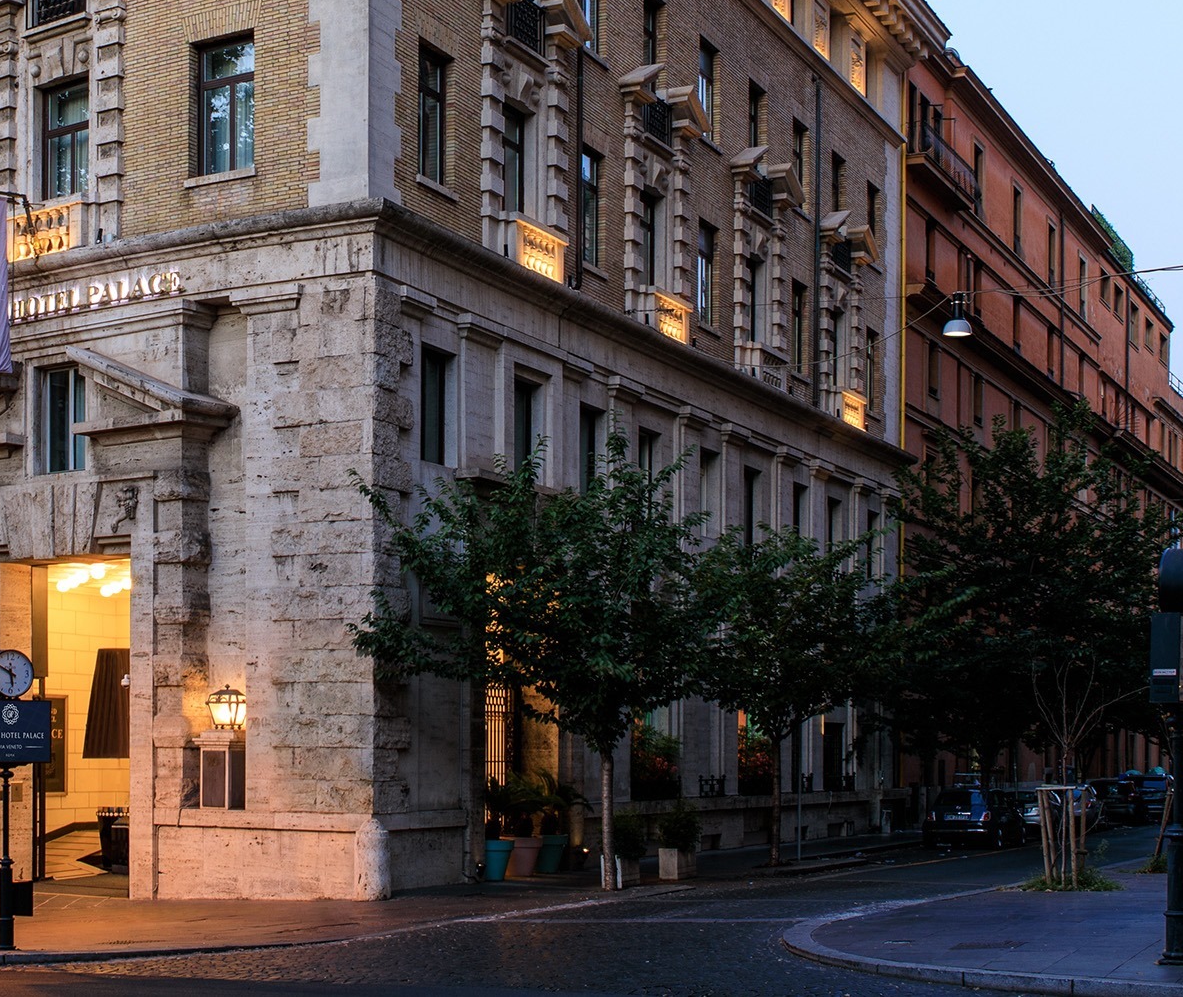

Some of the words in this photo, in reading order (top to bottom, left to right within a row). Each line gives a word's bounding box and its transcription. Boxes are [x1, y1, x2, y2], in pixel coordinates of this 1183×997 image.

[12, 288, 81, 319] HOTEL
[86, 271, 181, 305] PALACE
[6, 653, 15, 661] 12
[24, 670, 29, 678] 3
[8, 686, 13, 694] 6
[1, 731, 21, 739] HOTEL
